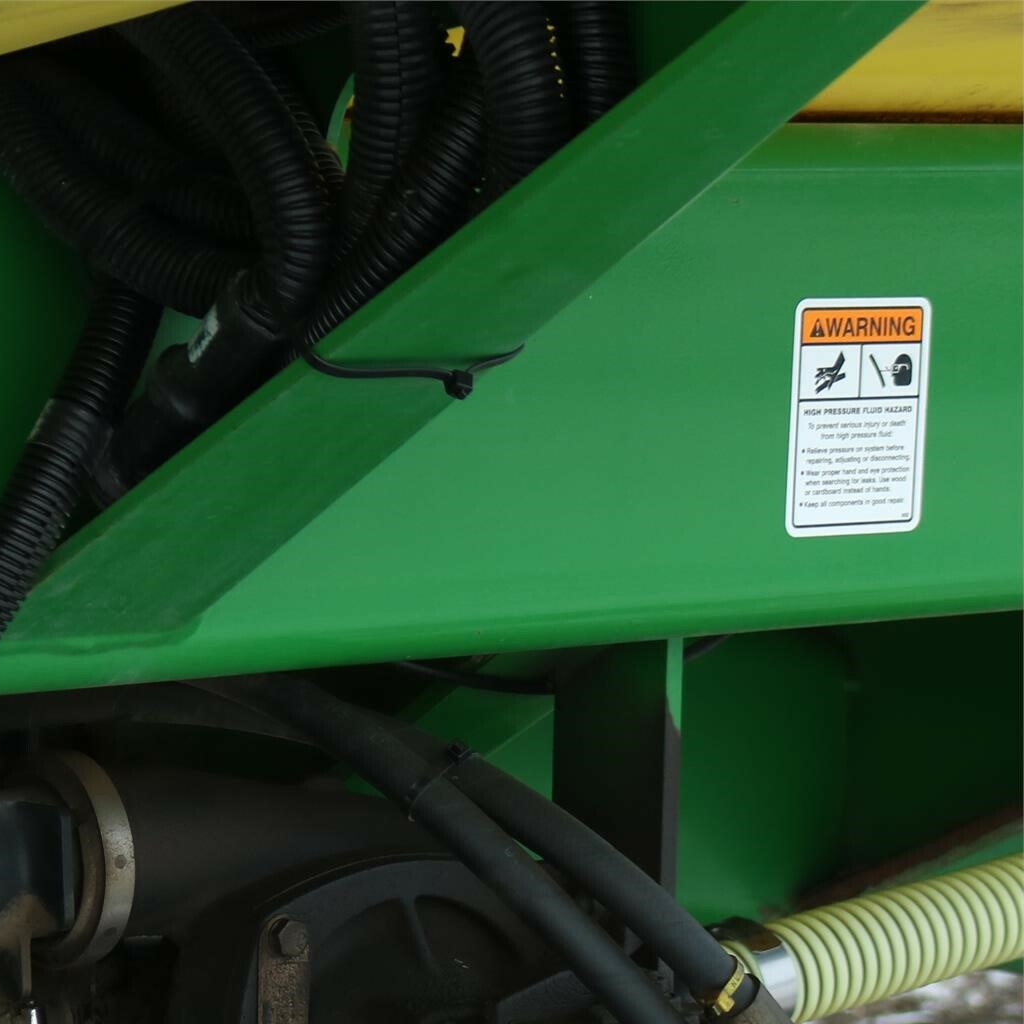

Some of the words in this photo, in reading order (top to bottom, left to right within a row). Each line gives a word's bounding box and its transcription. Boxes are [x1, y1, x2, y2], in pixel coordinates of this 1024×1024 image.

[826, 316, 916, 338] WARNING
[803, 408, 822, 416] HIGH
[823, 407, 860, 416] PRESSURE
[862, 406, 883, 414] FLUID
[884, 405, 913, 413] HAZARD
[808, 422, 815, 430] To
[816, 422, 839, 431] prevent
[863, 421, 880, 429] injury
[820, 432, 835, 440] from
[836, 432, 849, 440] high
[850, 432, 877, 440] pressure
[806, 457, 833, 465] repairing,
[835, 456, 861, 464] adjusting
[822, 479, 850, 487] searching
[812, 488, 841, 496] cardboard
[872, 498, 886, 506] good
